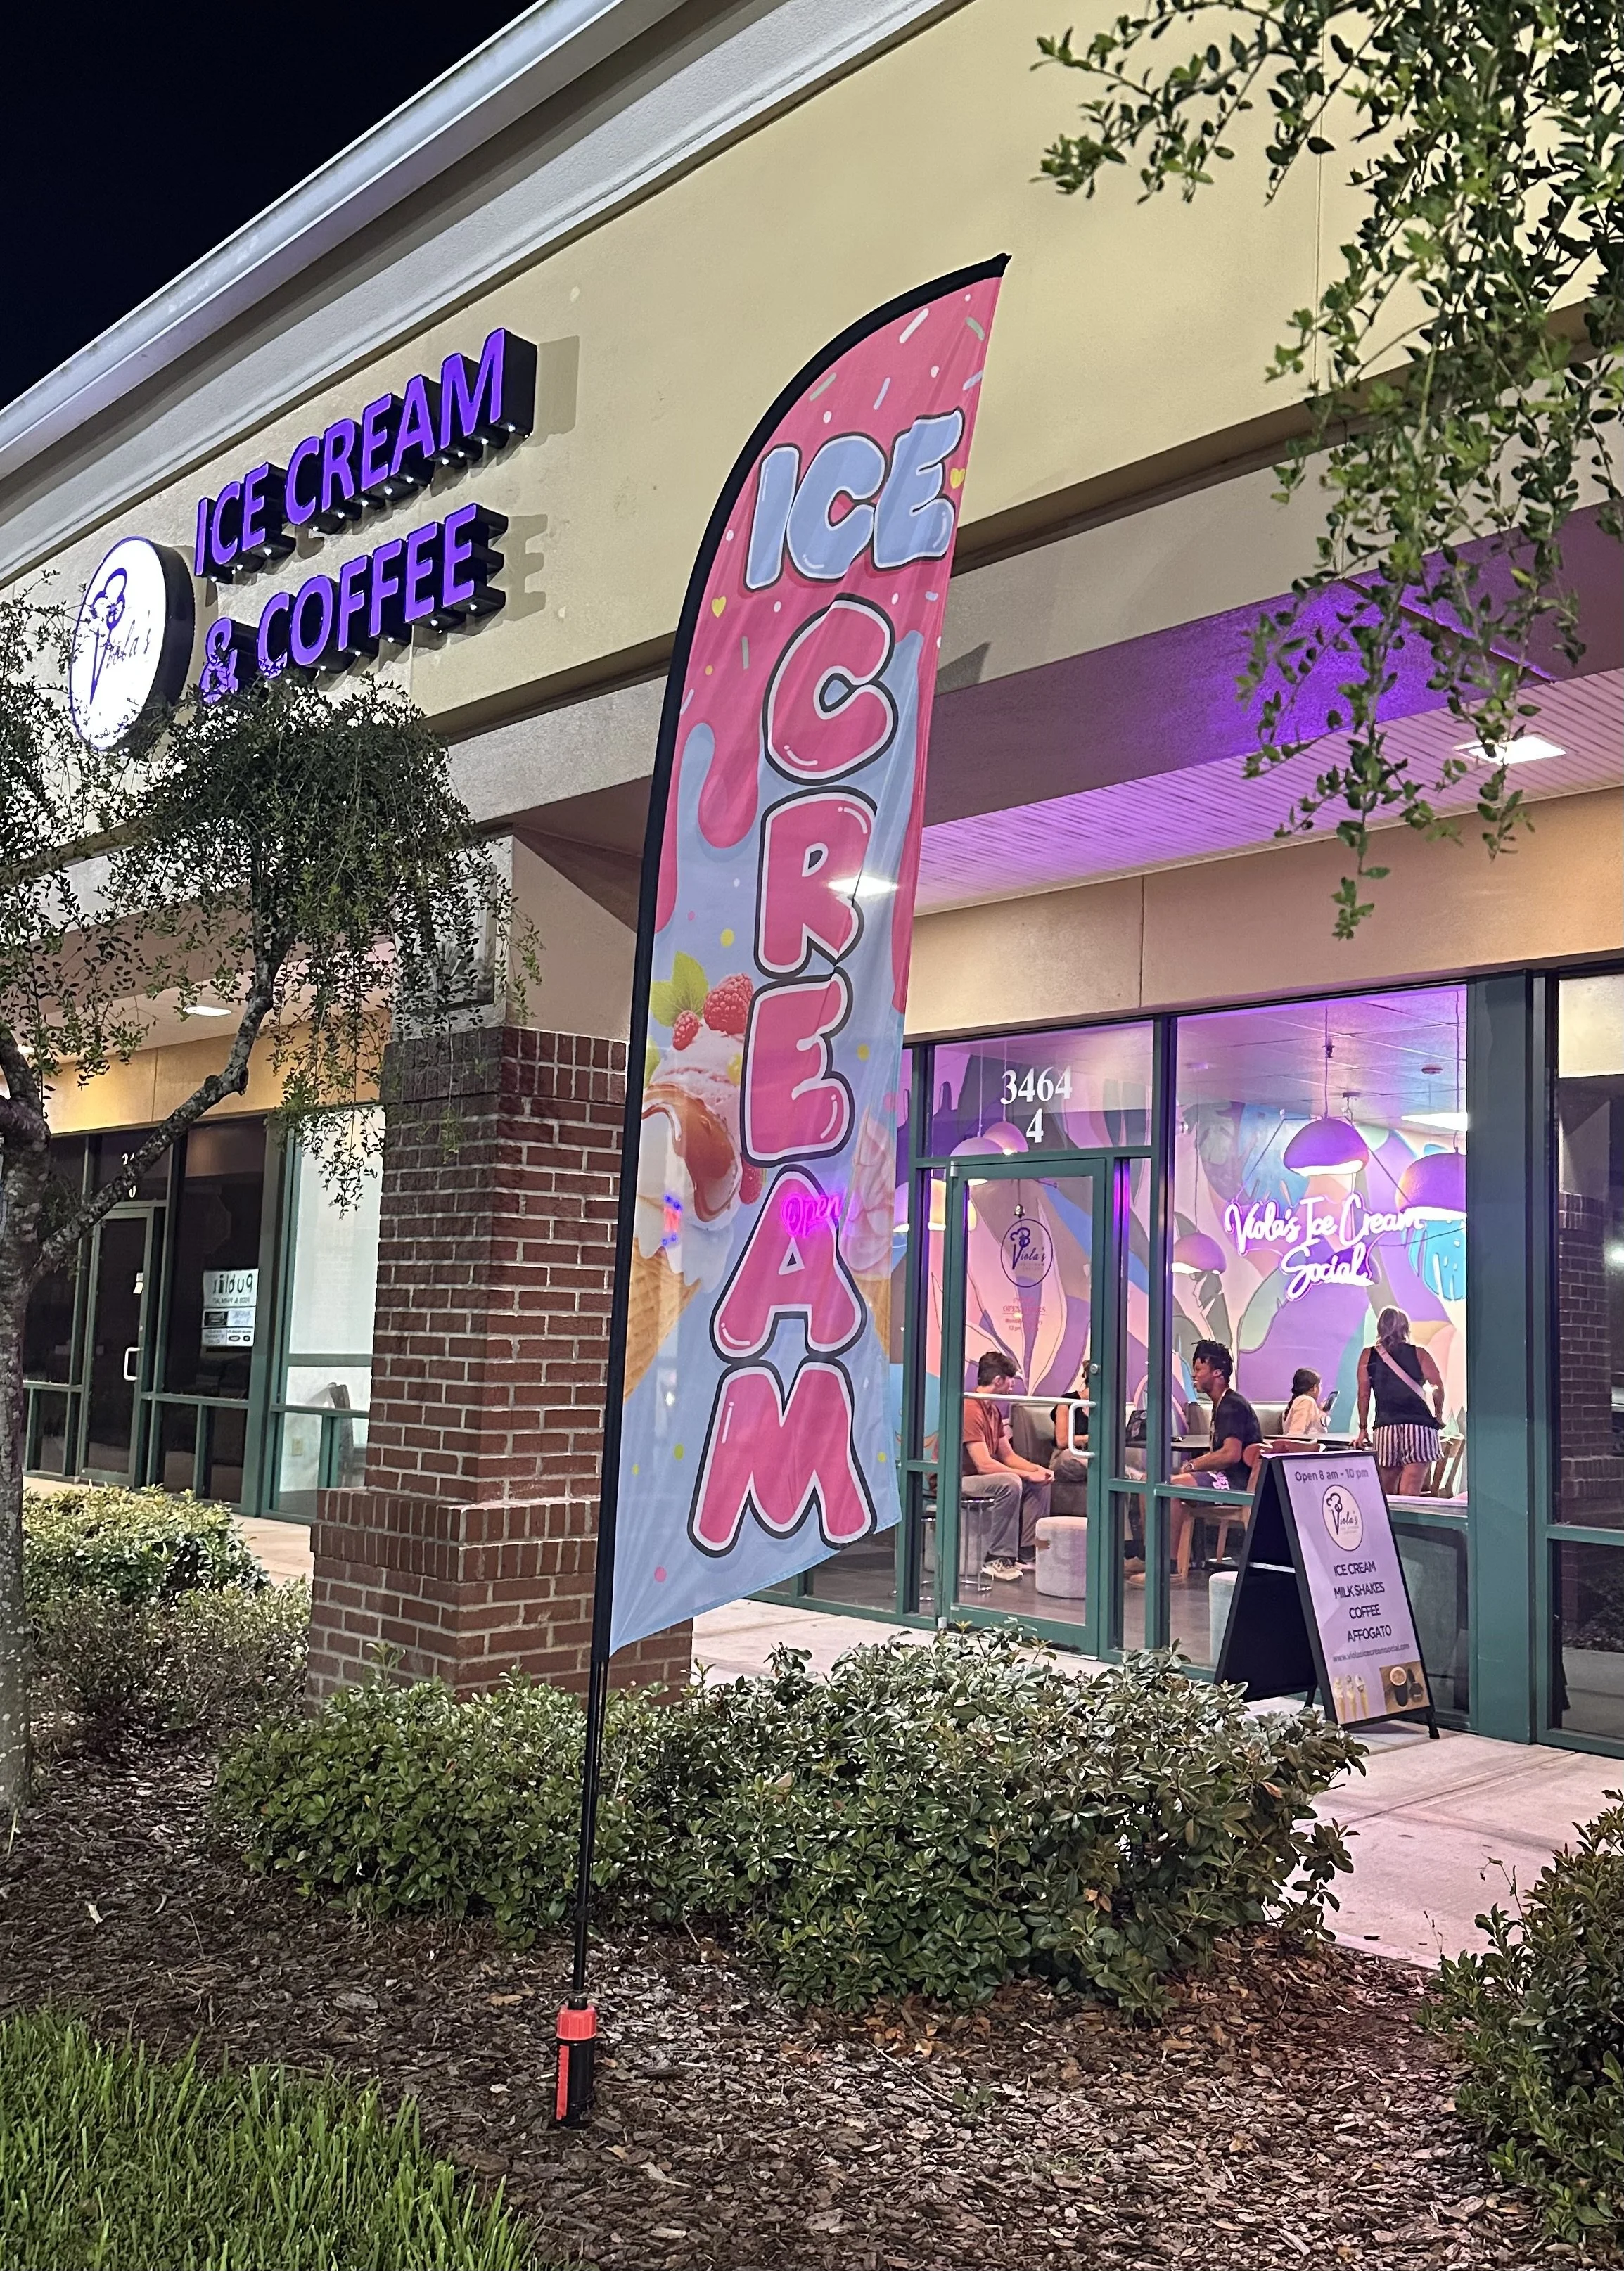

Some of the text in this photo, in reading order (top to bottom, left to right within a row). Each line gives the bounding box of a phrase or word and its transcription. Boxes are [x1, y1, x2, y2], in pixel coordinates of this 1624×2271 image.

[196, 327, 506, 578] ICE CREAM
[743, 408, 964, 591] ICE
[199, 502, 480, 703] & COFFEE
[687, 593, 899, 1557] CREAM
[999, 1066, 1073, 1105] 3464
[1025, 1108, 1044, 1144] 4
[781, 1192, 841, 1239] Open
[1224, 1193, 1424, 1255] Viola's Ice Cream
[1011, 1243, 1047, 1271] Viola's
[1281, 1241, 1374, 1300] Social
[1295, 1471, 1318, 1483] Open
[1319, 1470, 1325, 1480] 8
[1326, 1471, 1339, 1480] am
[1344, 1468, 1355, 1478] 10
[1355, 1469, 1369, 1479] pm
[1334, 1561, 1377, 1577] ICE CREAM
[1333, 1581, 1385, 1599] MILK SHAKES
[1349, 1604, 1381, 1620] COFFEE
[1348, 1625, 1392, 1643] AFFOGATO
